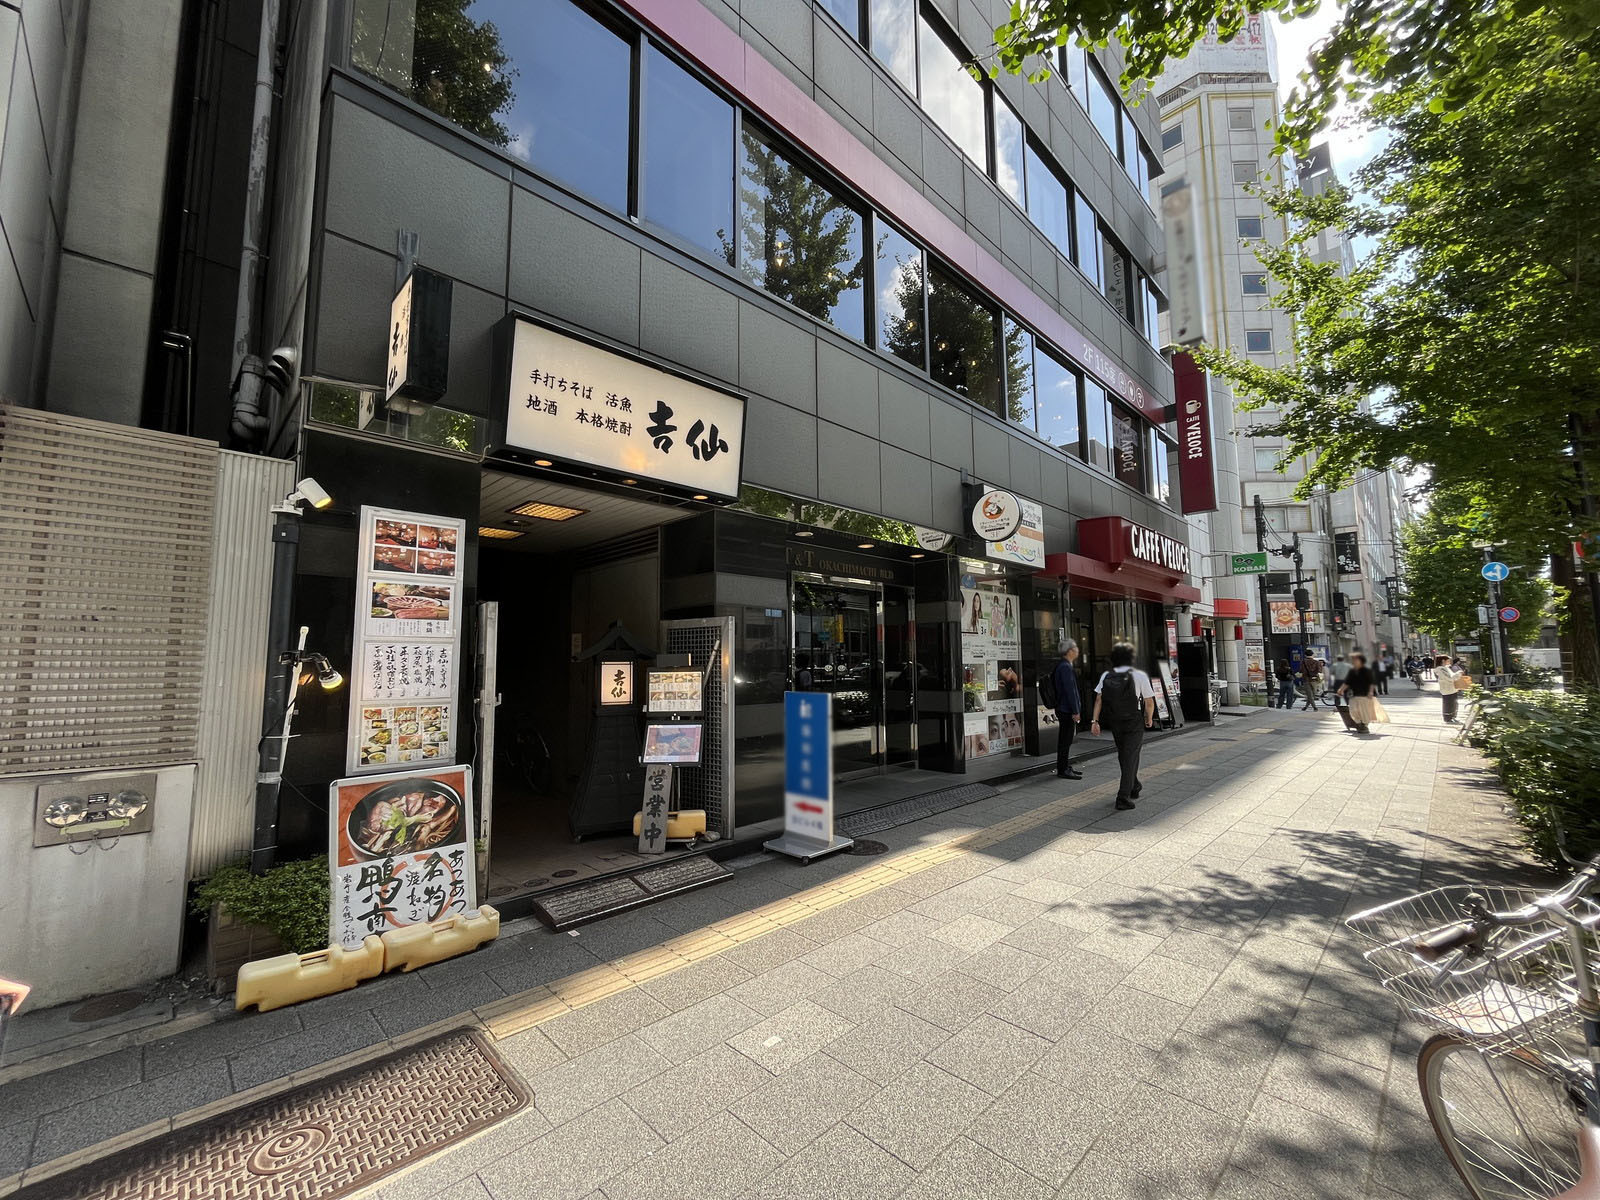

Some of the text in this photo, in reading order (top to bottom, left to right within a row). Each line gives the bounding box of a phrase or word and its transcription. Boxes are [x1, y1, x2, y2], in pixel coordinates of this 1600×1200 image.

[529, 368, 633, 413] 手打ちそば 活魚
[526, 394, 632, 436] 地酒 本格焼酎
[1187, 422, 1203, 459] VELOCE
[1160, 535, 1190, 574] VELOCE
[1233, 565, 1266, 573] KOBAN
[643, 768, 666, 849] 営業中
[356, 855, 404, 940] 鴨南
[421, 851, 447, 922] 名物
[448, 849, 467, 914] あつあつ
